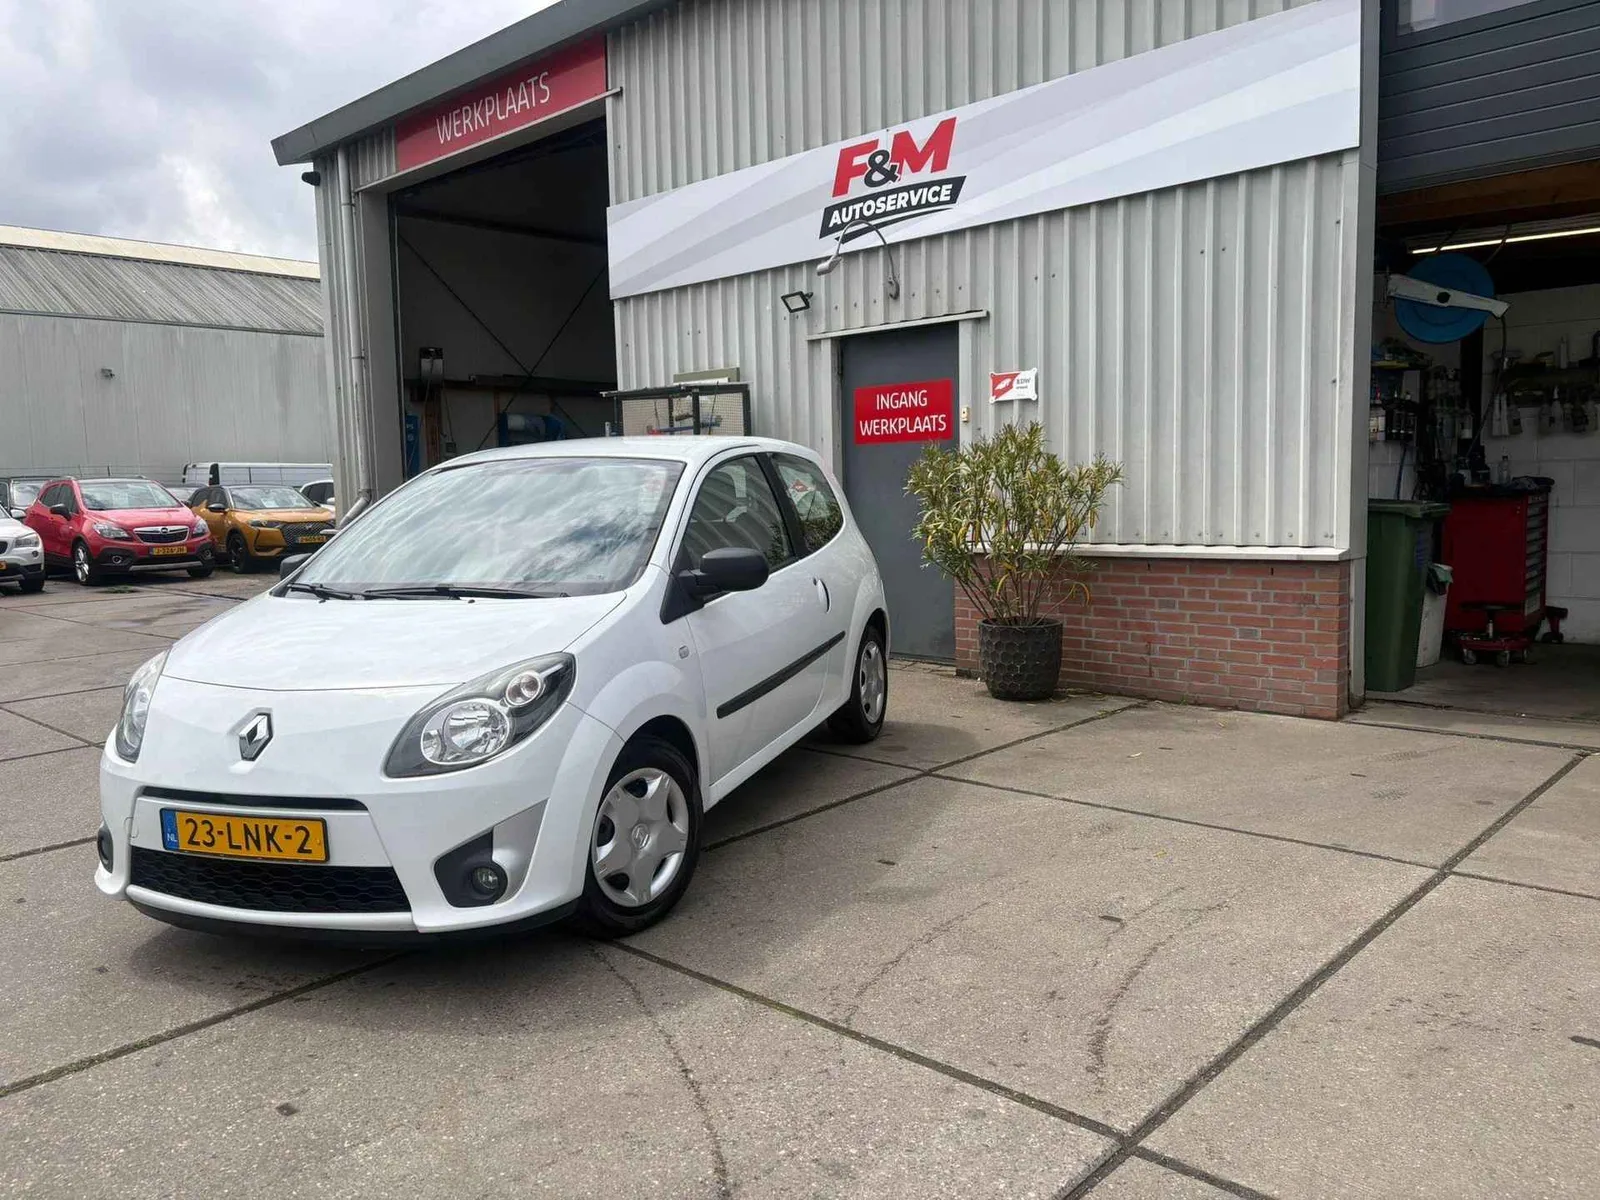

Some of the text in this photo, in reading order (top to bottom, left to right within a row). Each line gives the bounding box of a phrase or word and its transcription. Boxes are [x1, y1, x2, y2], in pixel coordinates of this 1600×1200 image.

[436, 71, 551, 145] WERKPLAATS
[832, 116, 957, 198] F&M
[829, 184, 953, 228] AUTOSERVICE
[876, 389, 928, 411] INGANG
[859, 413, 947, 437] WERKPLAATS
[167, 817, 313, 854] NL 23-LNK-2
